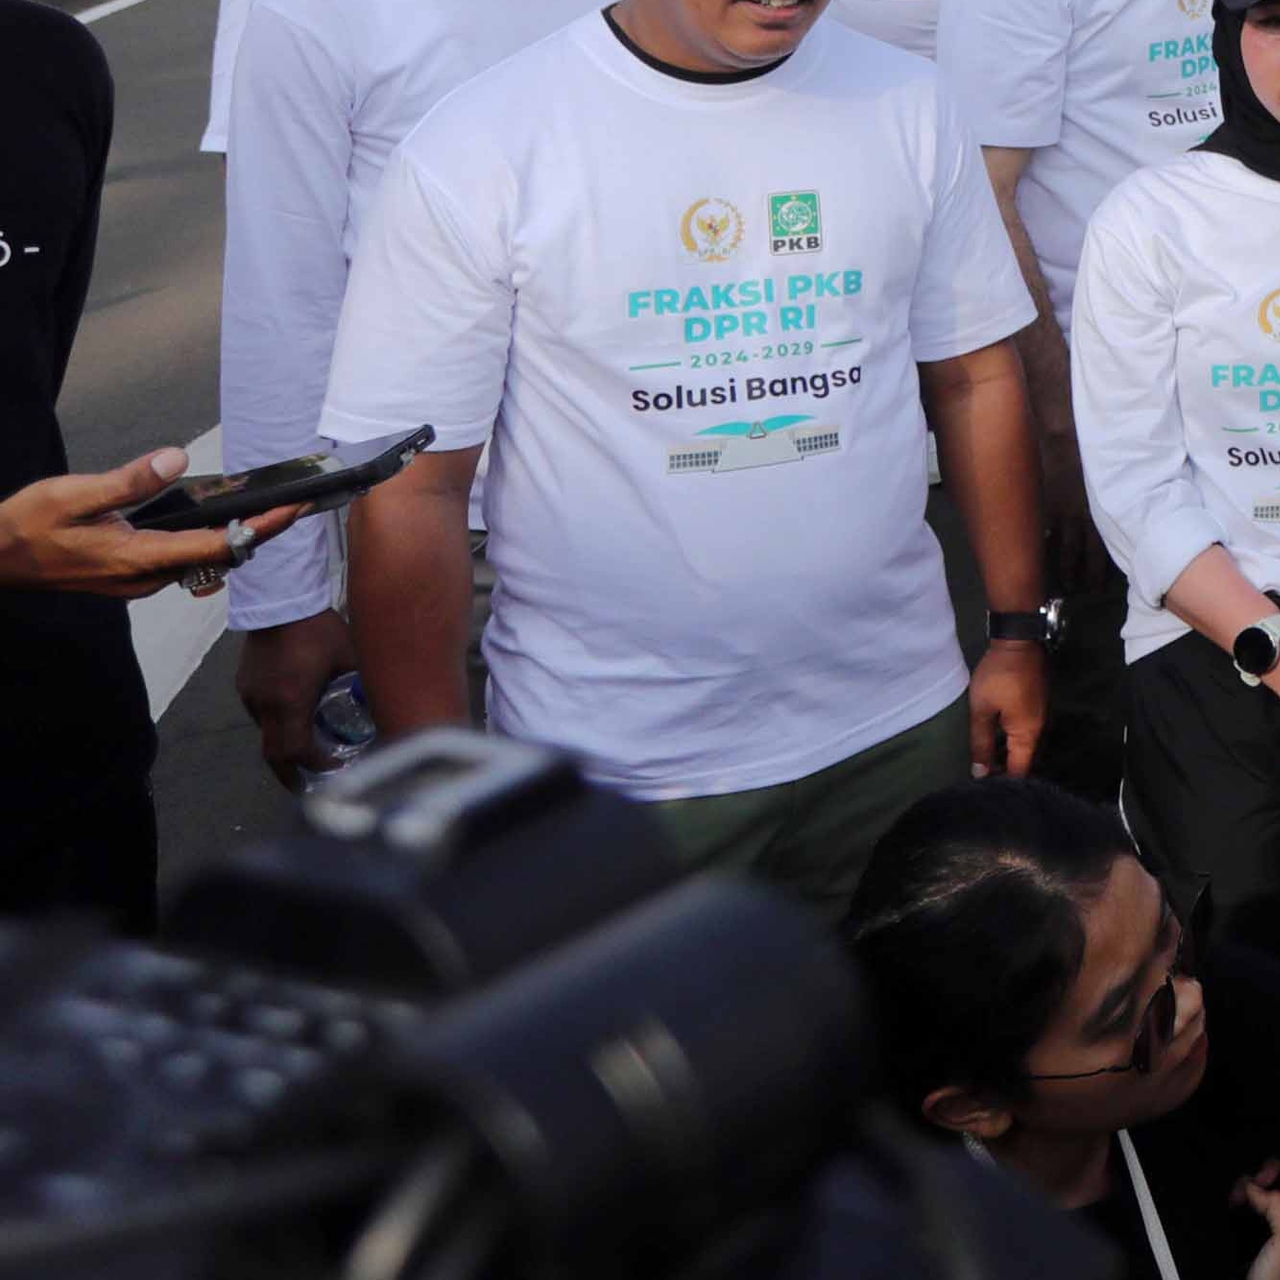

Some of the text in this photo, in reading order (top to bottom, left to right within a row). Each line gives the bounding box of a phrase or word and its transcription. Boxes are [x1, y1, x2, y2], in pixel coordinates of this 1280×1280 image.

[1148, 33, 1213, 62] FRAK
[1148, 102, 1217, 127] Solusi
[773, 236, 820, 252] PKB
[627, 268, 864, 318] FRAKSI PKB
[683, 304, 816, 343] DPR RI
[690, 340, 814, 368] 2024-2029
[631, 365, 862, 412] Solusi Bangsa
